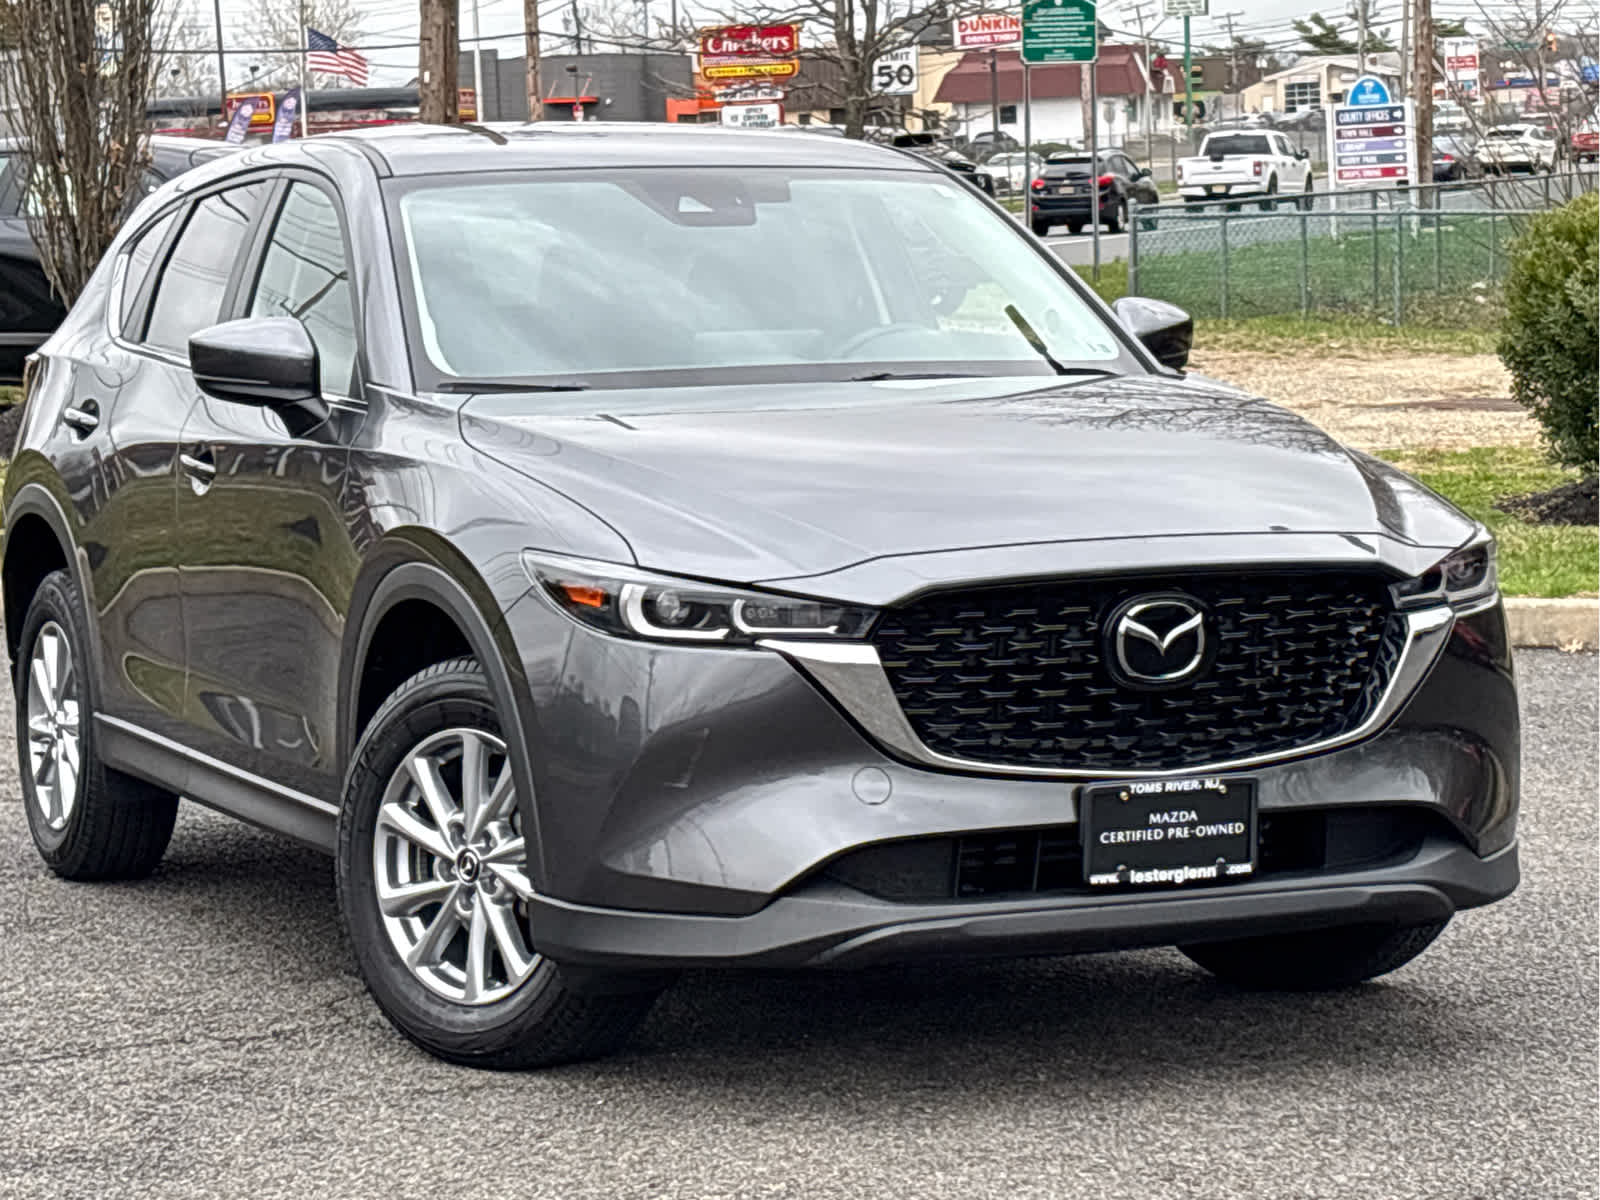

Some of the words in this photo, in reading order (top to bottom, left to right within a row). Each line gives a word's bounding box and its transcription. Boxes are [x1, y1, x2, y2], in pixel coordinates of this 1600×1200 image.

[994, 32, 1018, 41] THRU
[879, 51, 910, 62] LIMIT
[877, 64, 914, 87] 50
[1130, 782, 1163, 794] TOMS
[1149, 810, 1198, 824] MAZDA
[1100, 828, 1164, 844] CERTIFIED
[1167, 822, 1245, 840] PRE-OWNED
